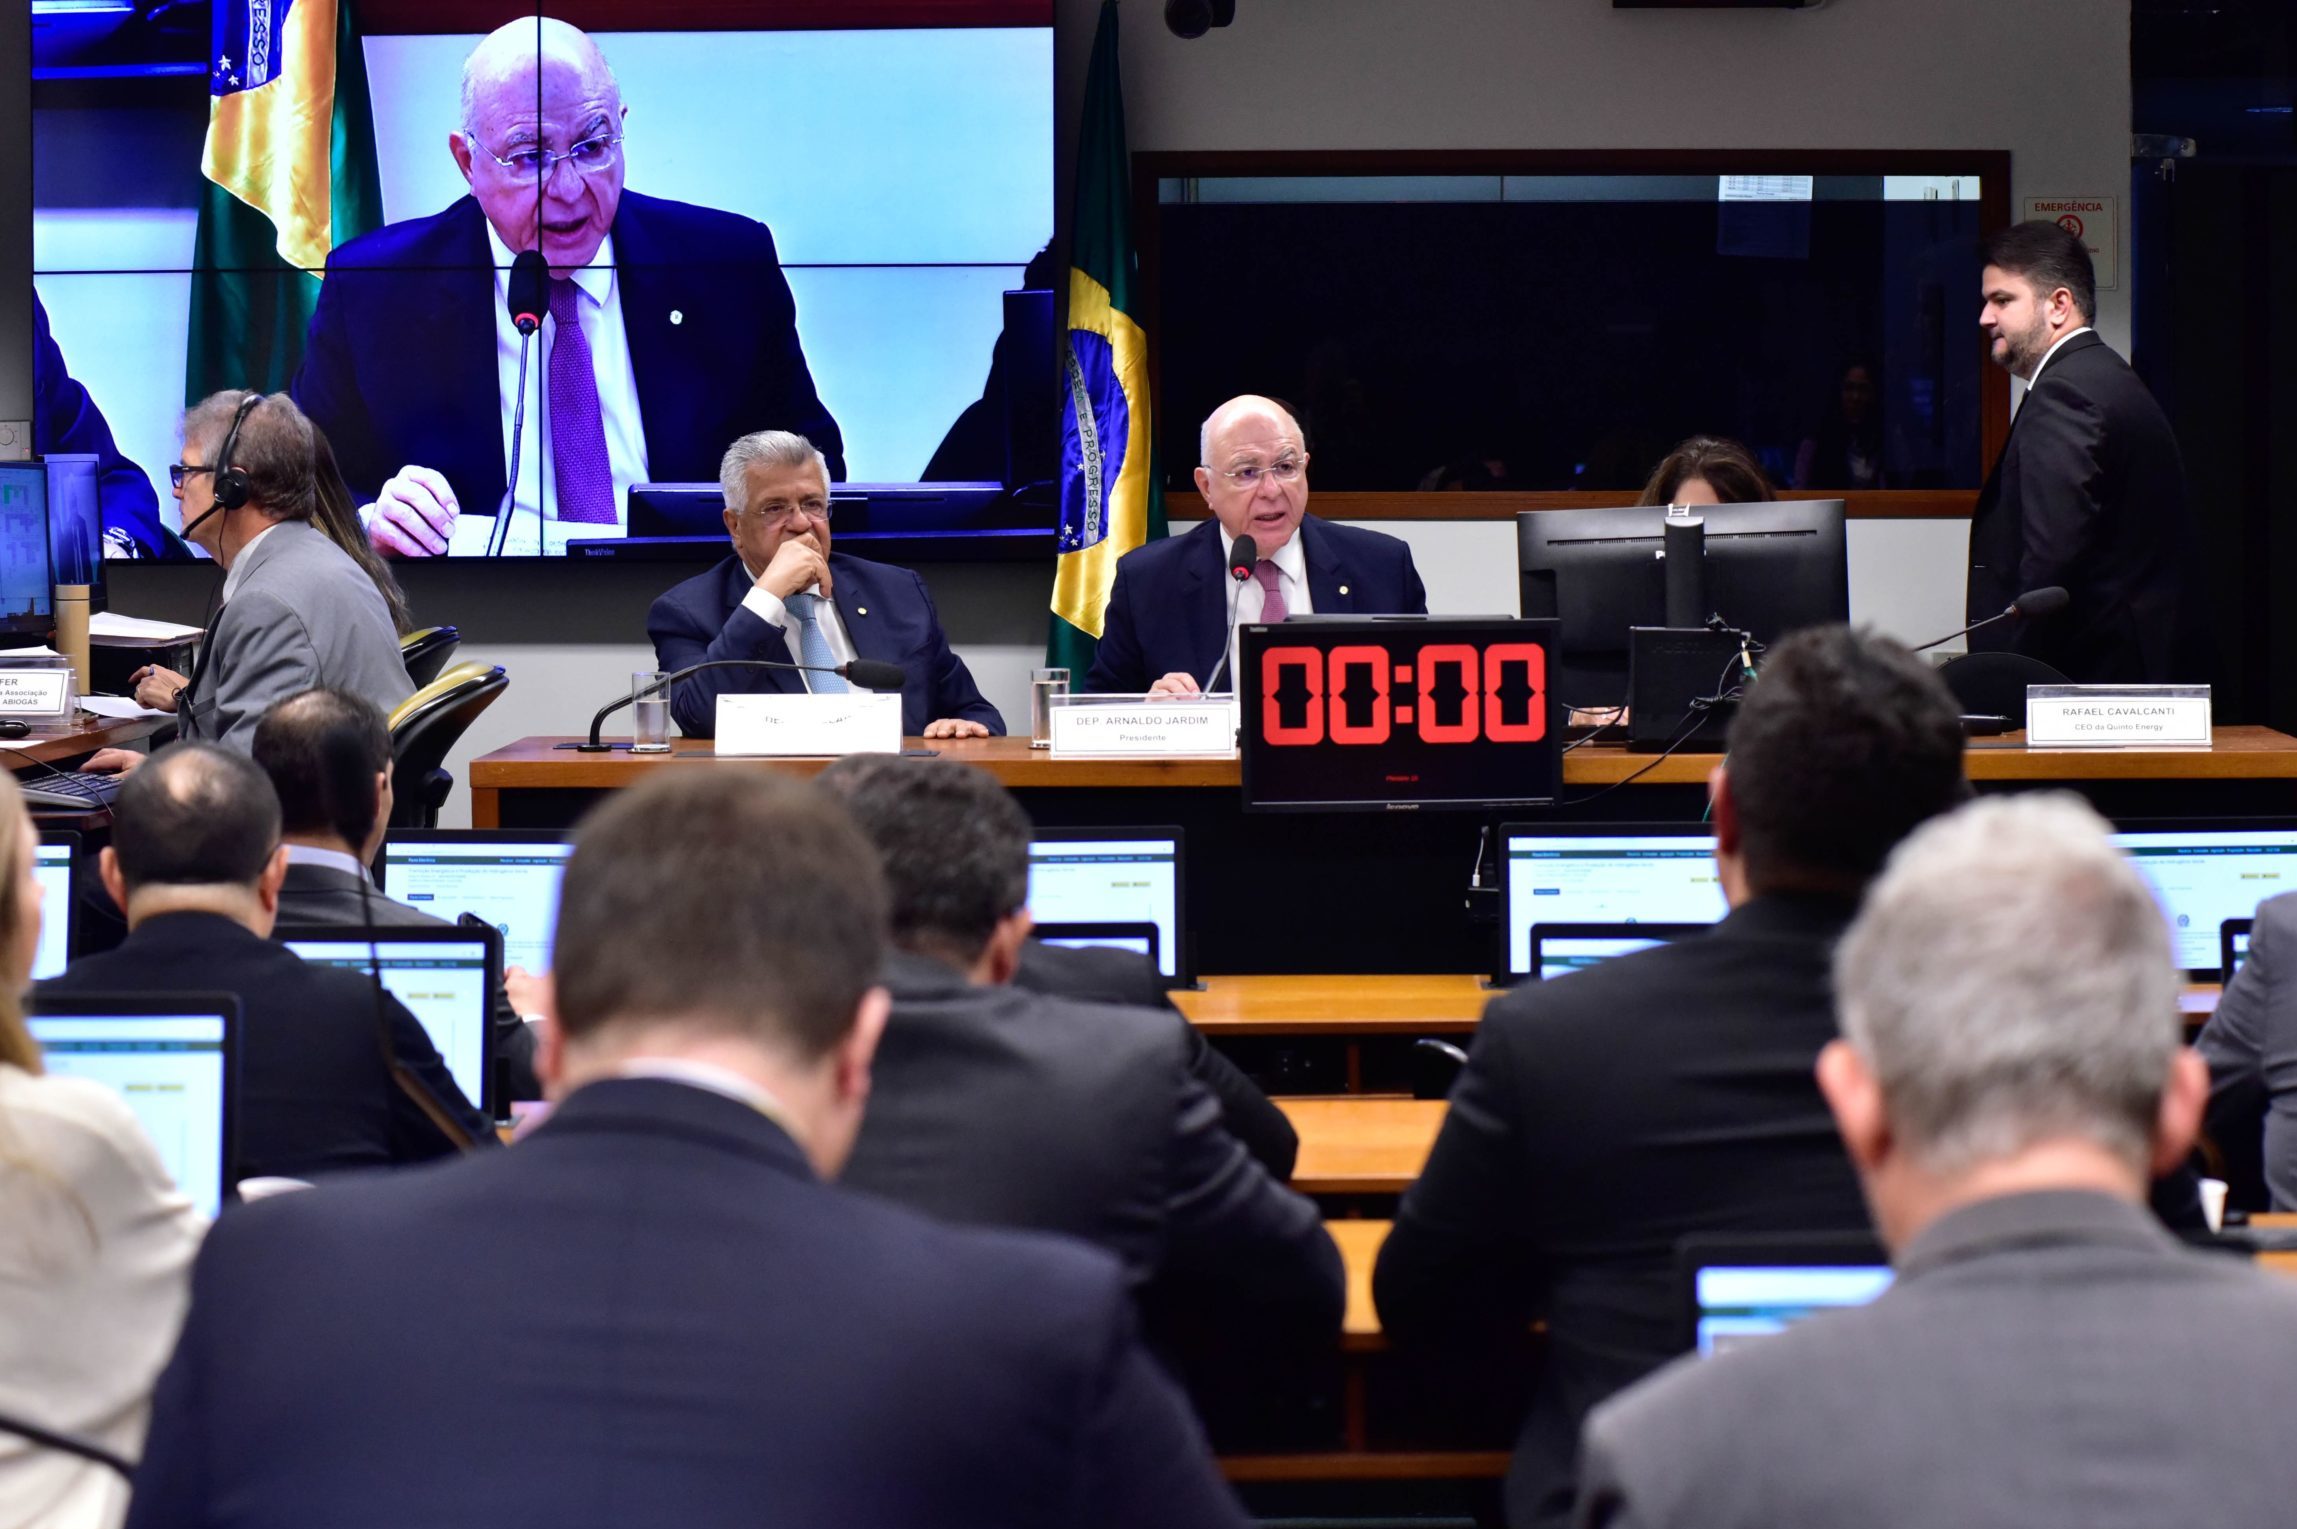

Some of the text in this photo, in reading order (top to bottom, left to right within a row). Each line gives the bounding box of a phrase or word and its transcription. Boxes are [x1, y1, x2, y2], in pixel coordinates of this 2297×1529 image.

[2034, 200, 2103, 212] EMERGÊNCIA
[1079, 413, 1088, 421] E
[1083, 428, 1099, 531] PROGRESSO
[1262, 643, 1546, 746] 00:00
[2062, 707, 2175, 716] RAFAEL CAVALCANTI
[1106, 716, 1162, 726] ARNALDO
[1165, 716, 1209, 725] JARDIM
[2075, 723, 2164, 732] CEO da Quinto Energy
[1119, 734, 1167, 742] Presidente
